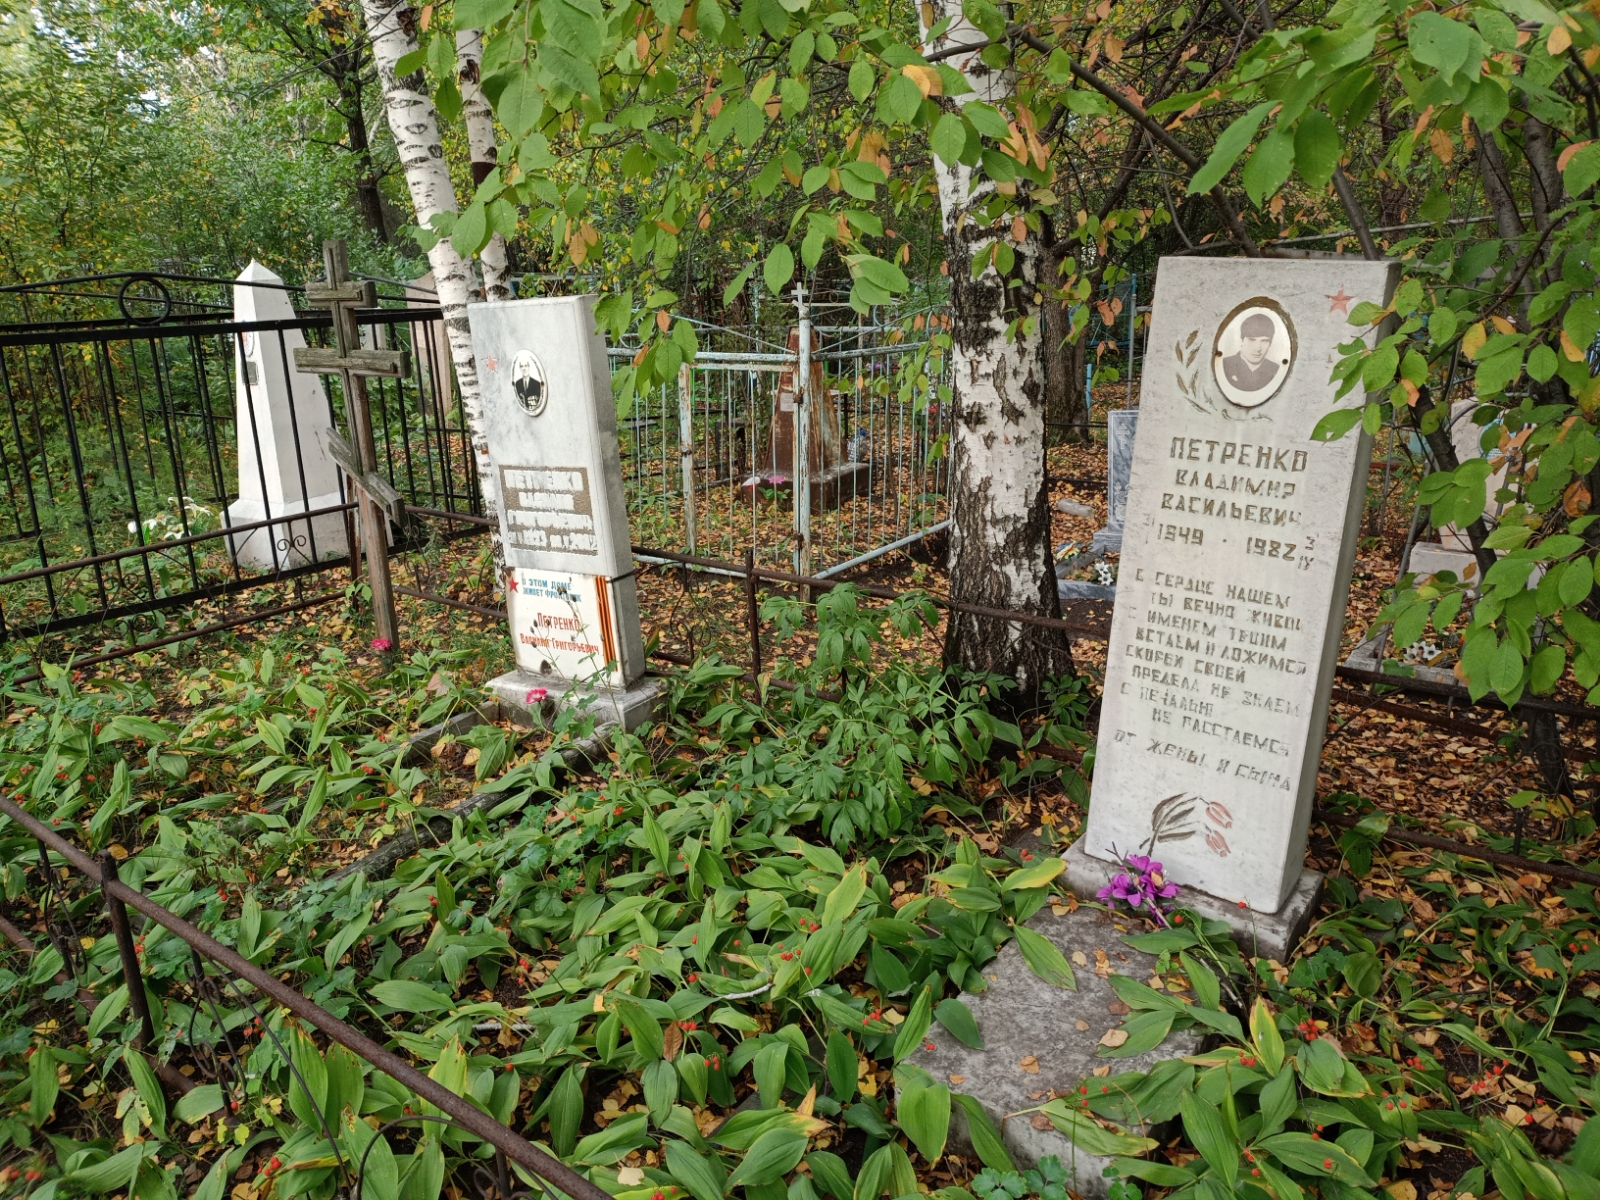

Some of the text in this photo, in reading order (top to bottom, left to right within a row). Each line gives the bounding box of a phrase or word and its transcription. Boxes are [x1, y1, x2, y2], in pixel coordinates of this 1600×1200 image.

[1170, 436, 1308, 472] ПЕТРЕНКО
[1175, 469, 1296, 499] ВЛАДИМИР
[1161, 492, 1302, 527] ВАСИЛЬЕВИЧ
[1157, 523, 1297, 562] 1949 1982
[528, 578, 548, 588] ЭТОМ
[1155, 571, 1215, 596] СЕРДЦЕ
[1226, 584, 1291, 609] НАШЕМ
[537, 612, 581, 631] ПЕТРЕНКО
[1150, 591, 1174, 608] ТЫ
[1183, 597, 1235, 619] ВЕЧНО
[1147, 610, 1217, 638] ИМЕНЕМ
[1228, 626, 1288, 652] ТВОИМ
[1135, 626, 1201, 653] ВСТАЕМ
[1220, 645, 1308, 676] ЛОЖИМСЯ
[1193, 658, 1246, 684] СВОЕЙ
[1132, 665, 1301, 718] ПРЕДЕЛА НЕ ЗНАЕМ
[1140, 686, 1214, 718] ПЕЧАЛЬЮ
[1152, 708, 1292, 757] НЕ РАССТАЕМСЯ
[1114, 729, 1137, 746] ОТ
[1146, 738, 1206, 767] ЖЕНЫ
[1235, 764, 1291, 792] СЫНА
